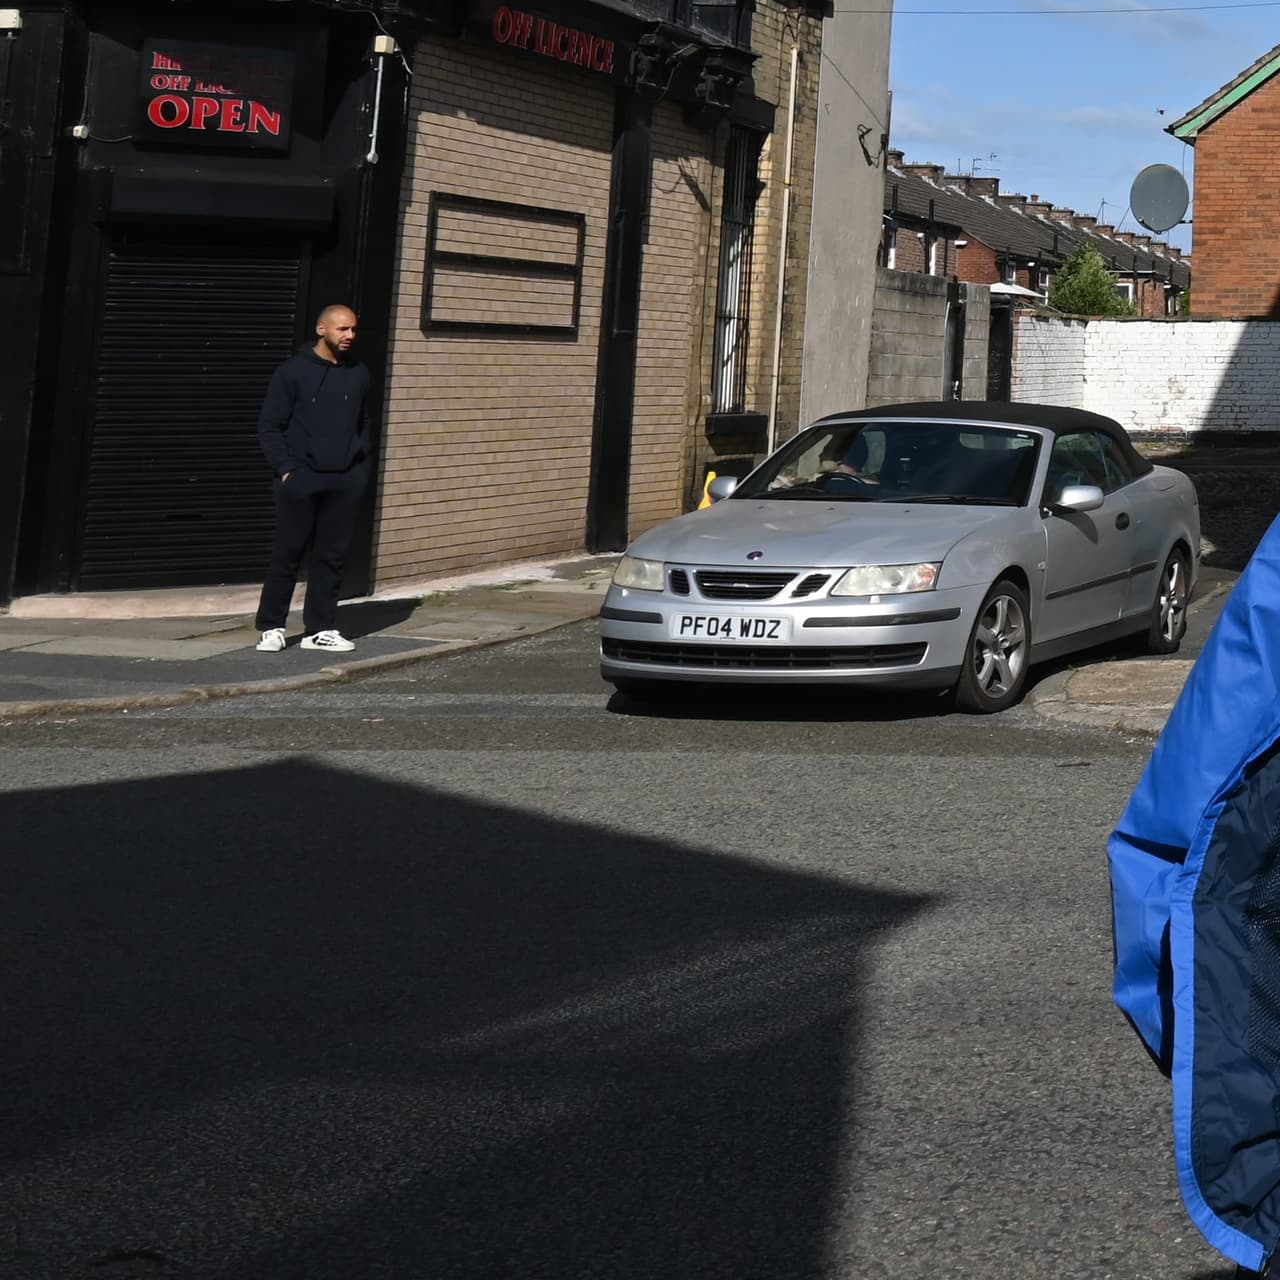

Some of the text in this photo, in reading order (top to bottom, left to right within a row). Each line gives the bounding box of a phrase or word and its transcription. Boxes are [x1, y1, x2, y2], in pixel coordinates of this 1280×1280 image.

[494, 6, 615, 75] OFF LICENCE
[150, 73, 191, 91] OFF
[147, 93, 281, 136] OPEN
[680, 616, 781, 639] PF04 WDZ
